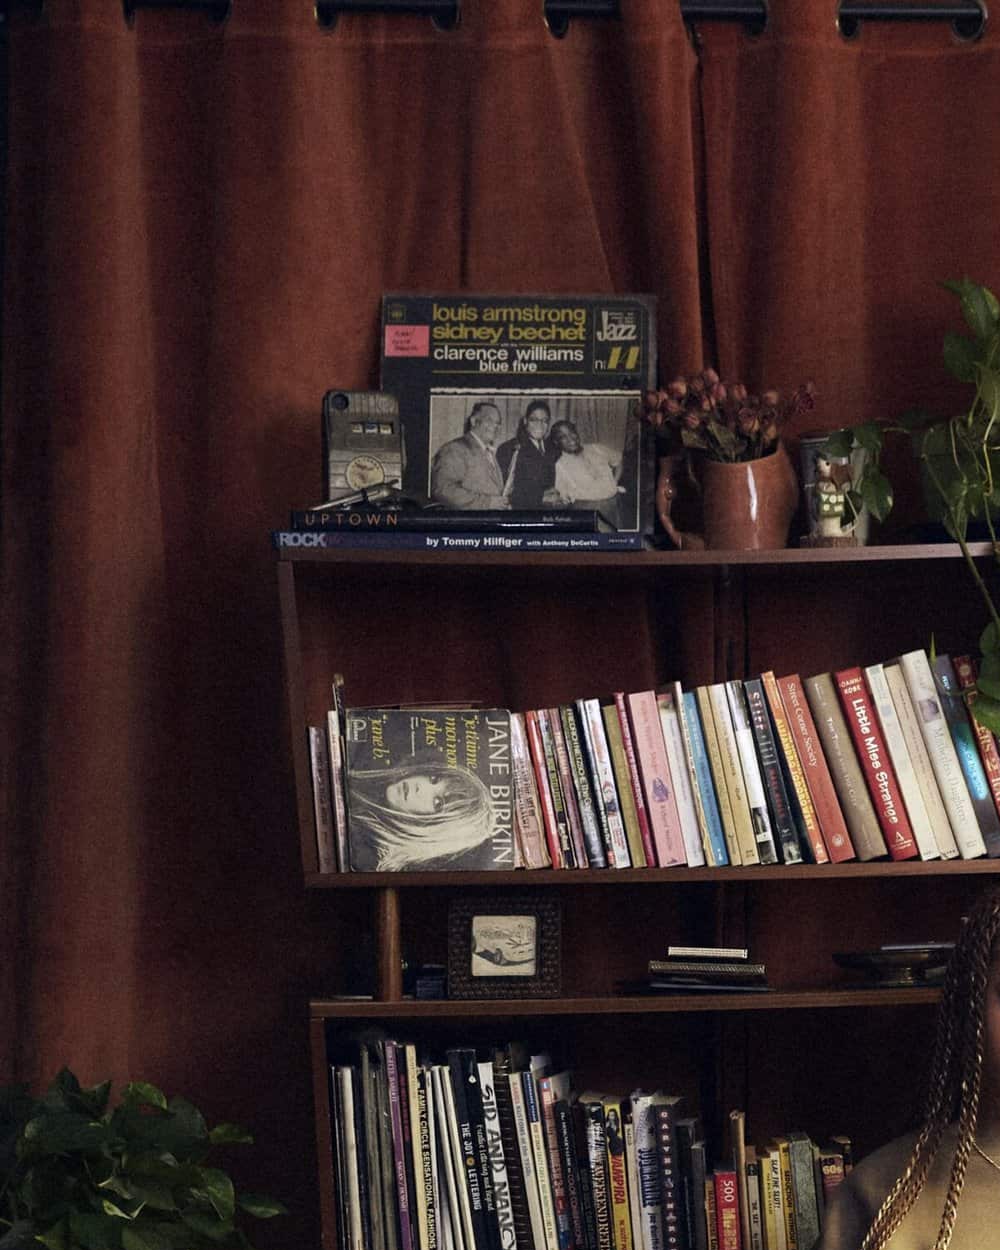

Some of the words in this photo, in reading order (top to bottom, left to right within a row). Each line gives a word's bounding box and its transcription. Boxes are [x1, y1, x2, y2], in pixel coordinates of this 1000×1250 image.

[433, 304, 478, 321] louis
[483, 307, 586, 325] armstrong
[596, 310, 637, 342] Jazz
[433, 324, 503, 344] sidney
[508, 324, 586, 341] bechet
[434, 345, 508, 361] clarence
[516, 345, 584, 361] williams
[479, 360, 509, 372] blue
[512, 360, 537, 372] five
[305, 514, 399, 526] UPTOWN
[279, 533, 328, 548] ROCK
[426, 537, 440, 548] by
[442, 537, 481, 548] Tommy
[482, 536, 523, 549] Hilfiger
[446, 717, 461, 741] moi
[787, 682, 800, 708] Street
[794, 706, 809, 737] Corner
[802, 735, 818, 768] Society
[446, 743, 458, 769] non
[485, 717, 510, 776] JANE
[776, 716, 795, 768] ALEJANDRO
[851, 697, 872, 735] Little
[863, 735, 883, 770] Miss
[873, 769, 899, 825] Strange
[490, 785, 513, 864] BIRKIN
[418, 1088, 426, 1119] FAMILY
[481, 1084, 496, 1121] SID
[460, 1121, 470, 1137] THE
[463, 1139, 473, 1156] JOY
[487, 1131, 506, 1174] AND
[424, 1150, 434, 1205] SENSATIONAL
[610, 1154, 624, 1204] VAMPIRA
[638, 1146, 660, 1208] SUBMARINE
[770, 1158, 778, 1175] SLAP
[466, 1167, 483, 1210] LETTERING
[567, 1173, 576, 1196] COLOR
[593, 1164, 606, 1222] WEEKEND
[724, 1180, 735, 1202] 500
[784, 1169, 793, 1208] SEDUCTION
[428, 1207, 437, 1249] FASHIONS
[787, 1212, 796, 1244] WITHOUT
